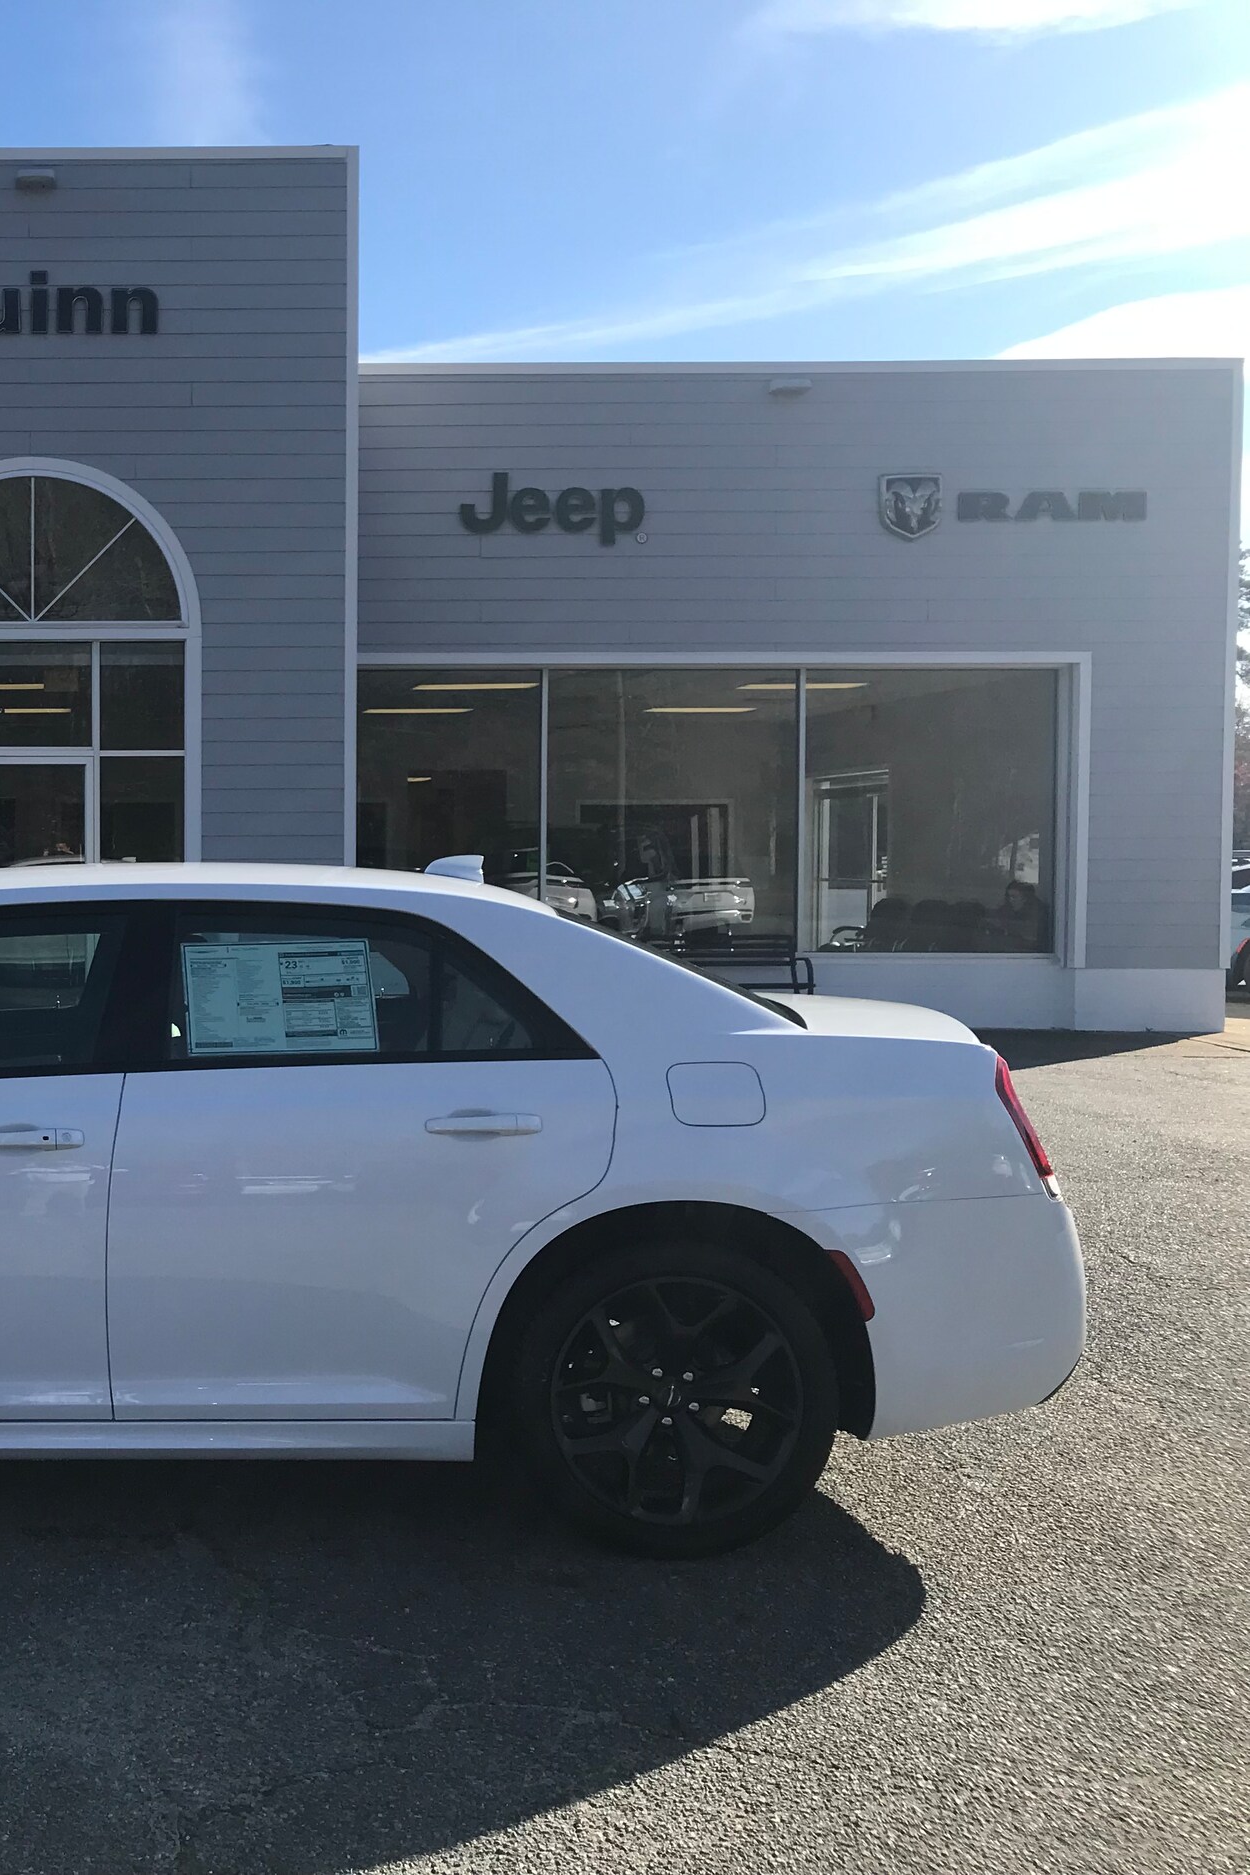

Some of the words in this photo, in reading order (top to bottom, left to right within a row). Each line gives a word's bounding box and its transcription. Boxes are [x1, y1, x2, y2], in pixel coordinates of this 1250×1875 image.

[460, 472, 646, 545] Jeep
[957, 490, 1148, 522] RAM
[285, 960, 298, 969] 23
